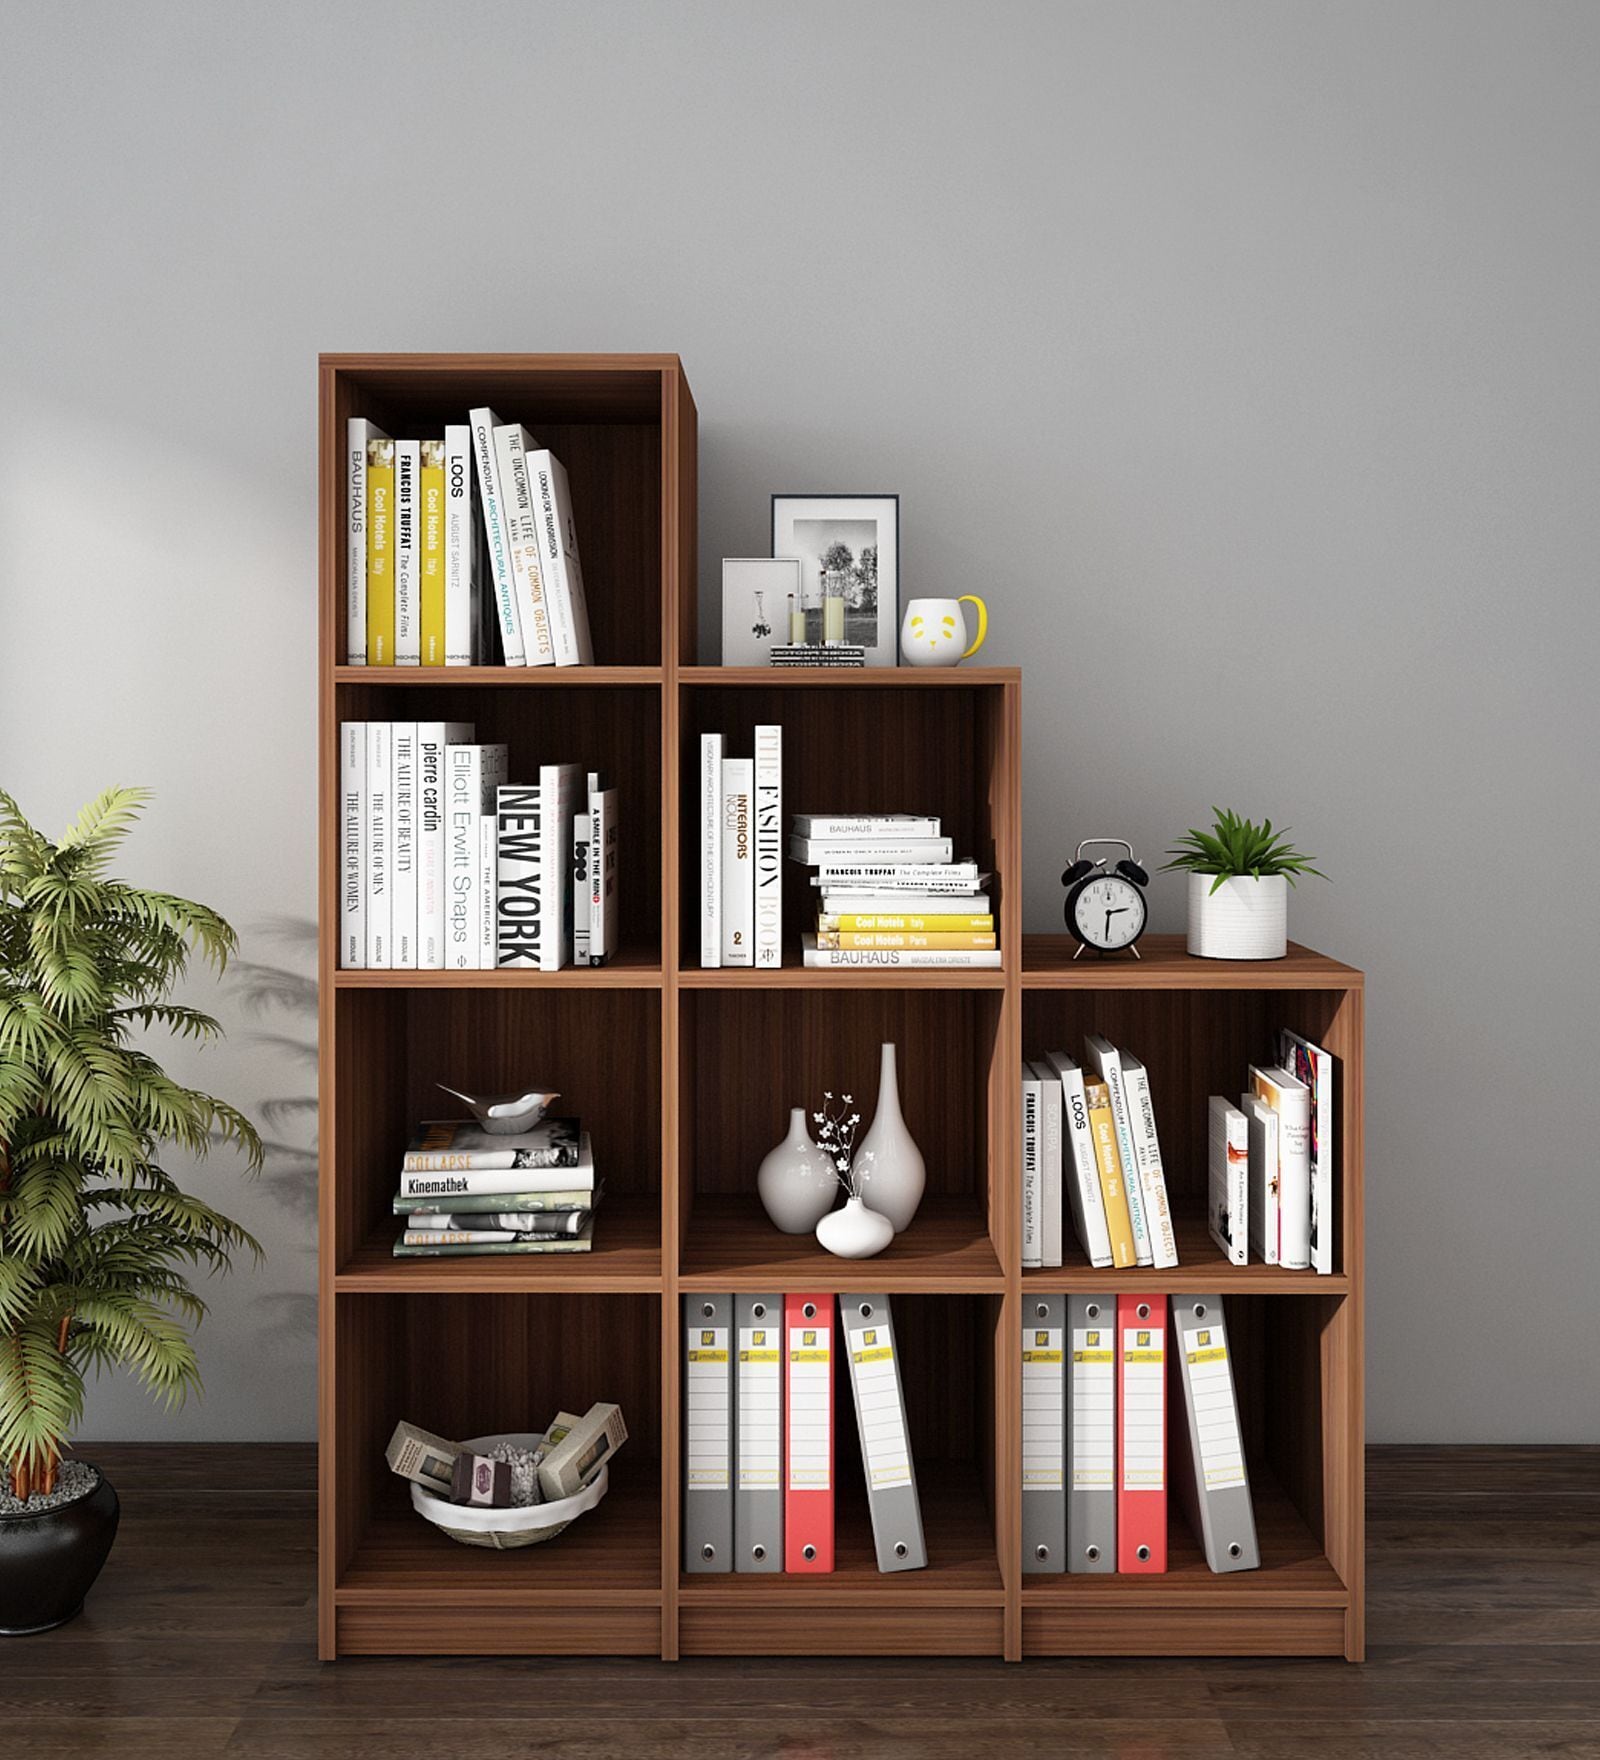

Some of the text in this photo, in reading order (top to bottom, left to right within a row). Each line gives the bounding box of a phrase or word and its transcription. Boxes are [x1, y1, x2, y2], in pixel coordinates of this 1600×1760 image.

[351, 451, 363, 533] BAUHAUS
[450, 455, 464, 499] LOOS
[372, 487, 386, 576] Cool Hotels Italy
[398, 455, 412, 638] FRANCOIS TRUFFAT The Complete Films
[425, 488, 439, 576] Cool Hotels Italy
[450, 513, 460, 589] AUGUST SARNITZ
[477, 425, 516, 636] COMPENDIUM ARCHITECTURAL ANTIQUES
[508, 433, 551, 655] THE UNCOMMON LIFE OF COMMON OBJECTS
[758, 728, 779, 779] THE
[397, 736, 412, 874] THE ALLURE OF BEAUTY
[420, 743, 442, 832] pierre cardin
[346, 791, 359, 913] THE ALLURE OF WOMEN
[372, 791, 384, 896] THE ALLURE OF MEN
[448, 751, 472, 943] Elliott Erwitt Snaps
[592, 817, 601, 845] SMILE
[592, 847, 601, 857] IN
[736, 793, 748, 860] INTERIORS
[758, 785, 779, 888] FASHION
[829, 825, 873, 834] BAUHAUS
[483, 866, 491, 885] THE
[498, 788, 541, 965] NEW YORK
[592, 859, 601, 877] THE
[825, 868, 862, 876] FRANCOIS
[864, 868, 896, 876] TRUFFAT
[912, 869, 944, 877] Complete
[483, 887, 491, 946] AMERICANS
[733, 931, 743, 945] 2
[854, 935, 928, 946] Cool Hotels Paris
[855, 917, 876, 929] Cool
[877, 917, 905, 929] Hotels
[830, 951, 900, 964] BAUHAUS
[1046, 1103, 1057, 1152] SCARPA
[1070, 1094, 1087, 1130] LOOS
[407, 1155, 473, 1171] COLLAPSE
[408, 1177, 469, 1194] Kinemathek
[1024, 1092, 1036, 1245] FRANCOIS TRUFFAT The Complete Films
[1078, 1142, 1091, 1171] AUGUST
[1097, 1122, 1118, 1198] Cool Hotels Paris
[1109, 1066, 1145, 1240] COMPENDIUM ARCHITECTURAL ANTIQUES
[1136, 1076, 1175, 1259] THE UNCOMMON LIFE OF COMMON OBJECTS
